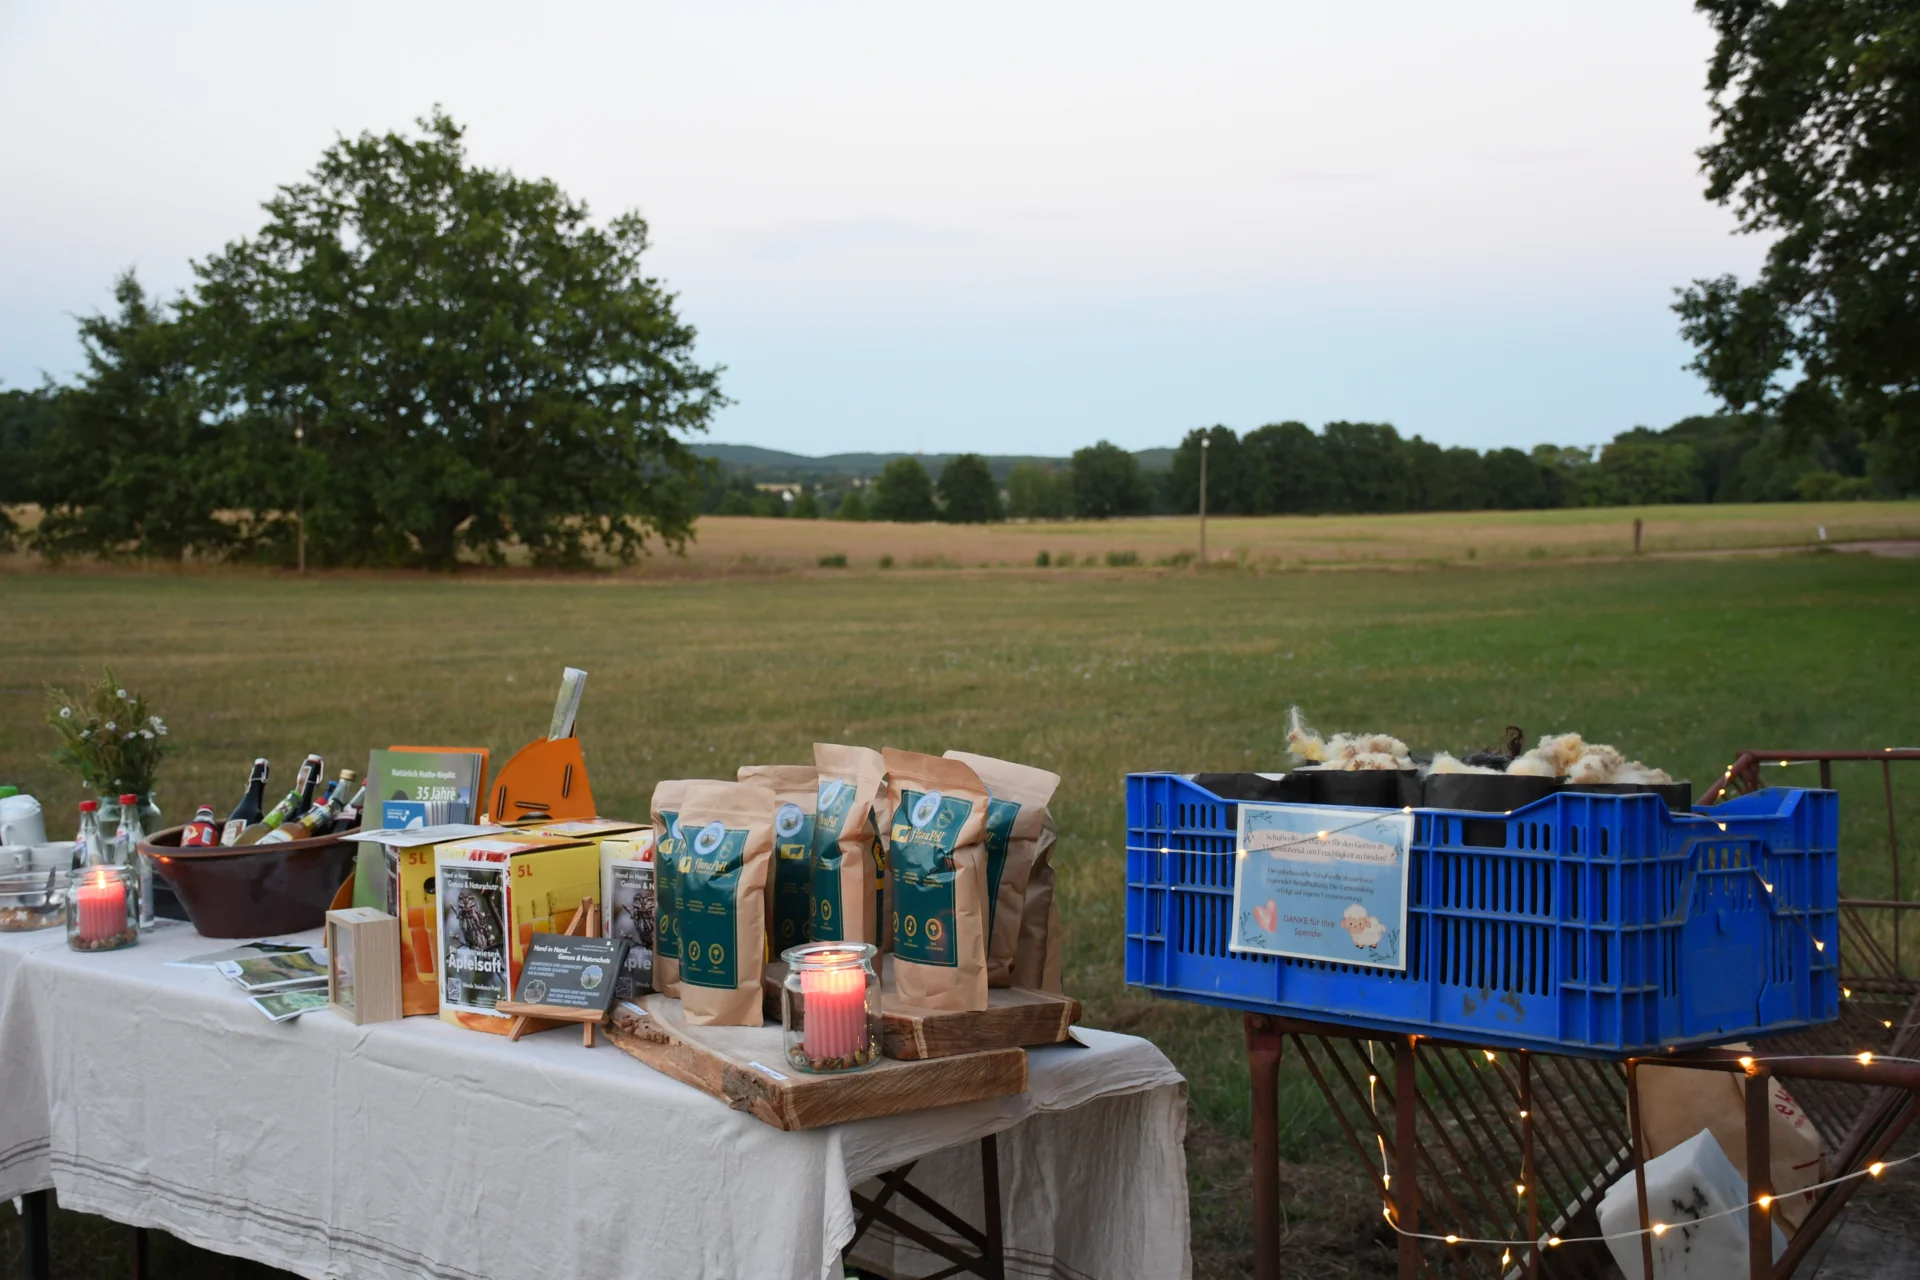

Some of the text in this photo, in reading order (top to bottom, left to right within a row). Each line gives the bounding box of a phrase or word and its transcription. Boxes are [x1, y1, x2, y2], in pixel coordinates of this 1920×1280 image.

[416, 786, 457, 801] 35 Jahre
[408, 853, 427, 865] 5L
[517, 864, 533, 877] 5L
[615, 872, 629, 880] Hand
[464, 881, 469, 889] &
[643, 882, 649, 890] &
[1283, 914, 1336, 929] DANKE für Ihre
[1294, 928, 1323, 939] Spende!
[533, 944, 548, 952] Hand
[557, 953, 611, 964] Genuss & Naturschutz
